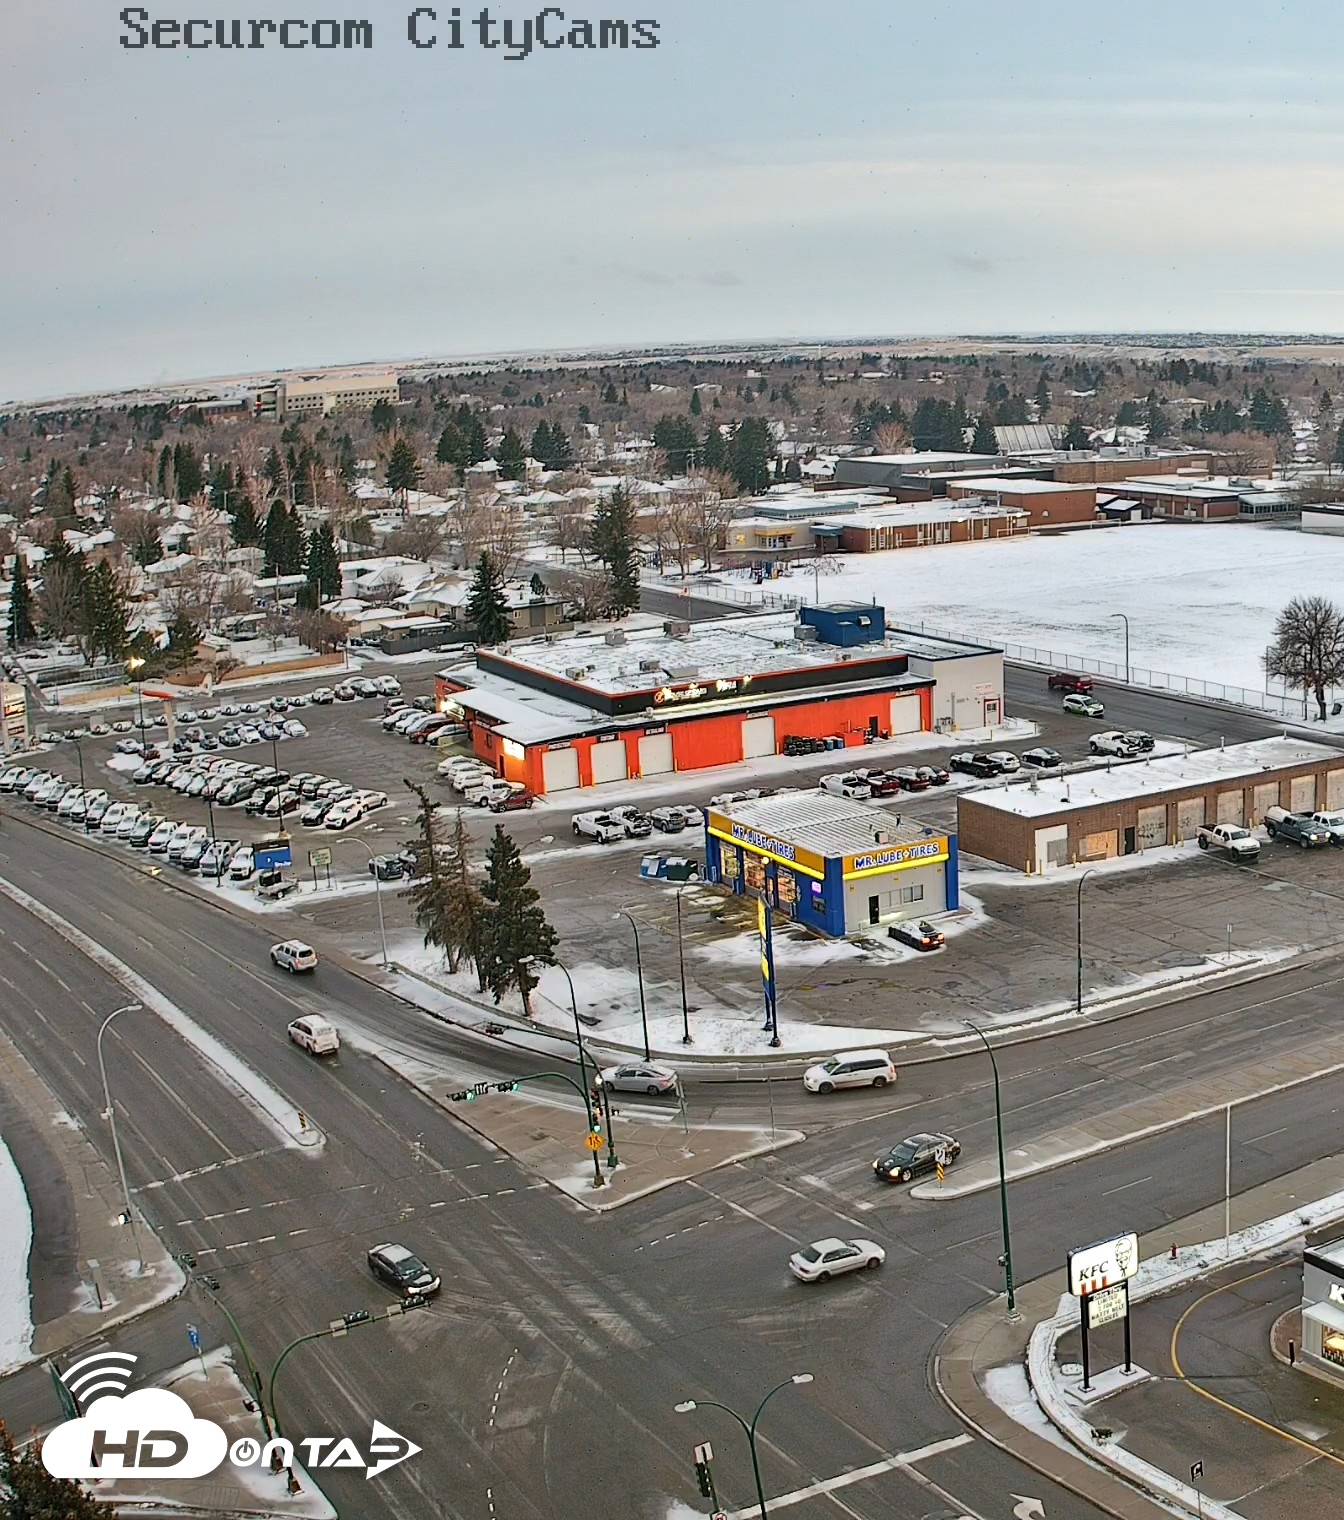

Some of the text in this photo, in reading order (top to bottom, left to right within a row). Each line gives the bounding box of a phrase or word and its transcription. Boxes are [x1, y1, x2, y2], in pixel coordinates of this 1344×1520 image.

[746, 831, 767, 848] LUBE
[771, 838, 795, 860] TIRES
[855, 855, 876, 870] MR.
[877, 850, 903, 865] LUBE
[909, 842, 939, 860] TIRES
[1079, 1260, 1109, 1282] KFC
